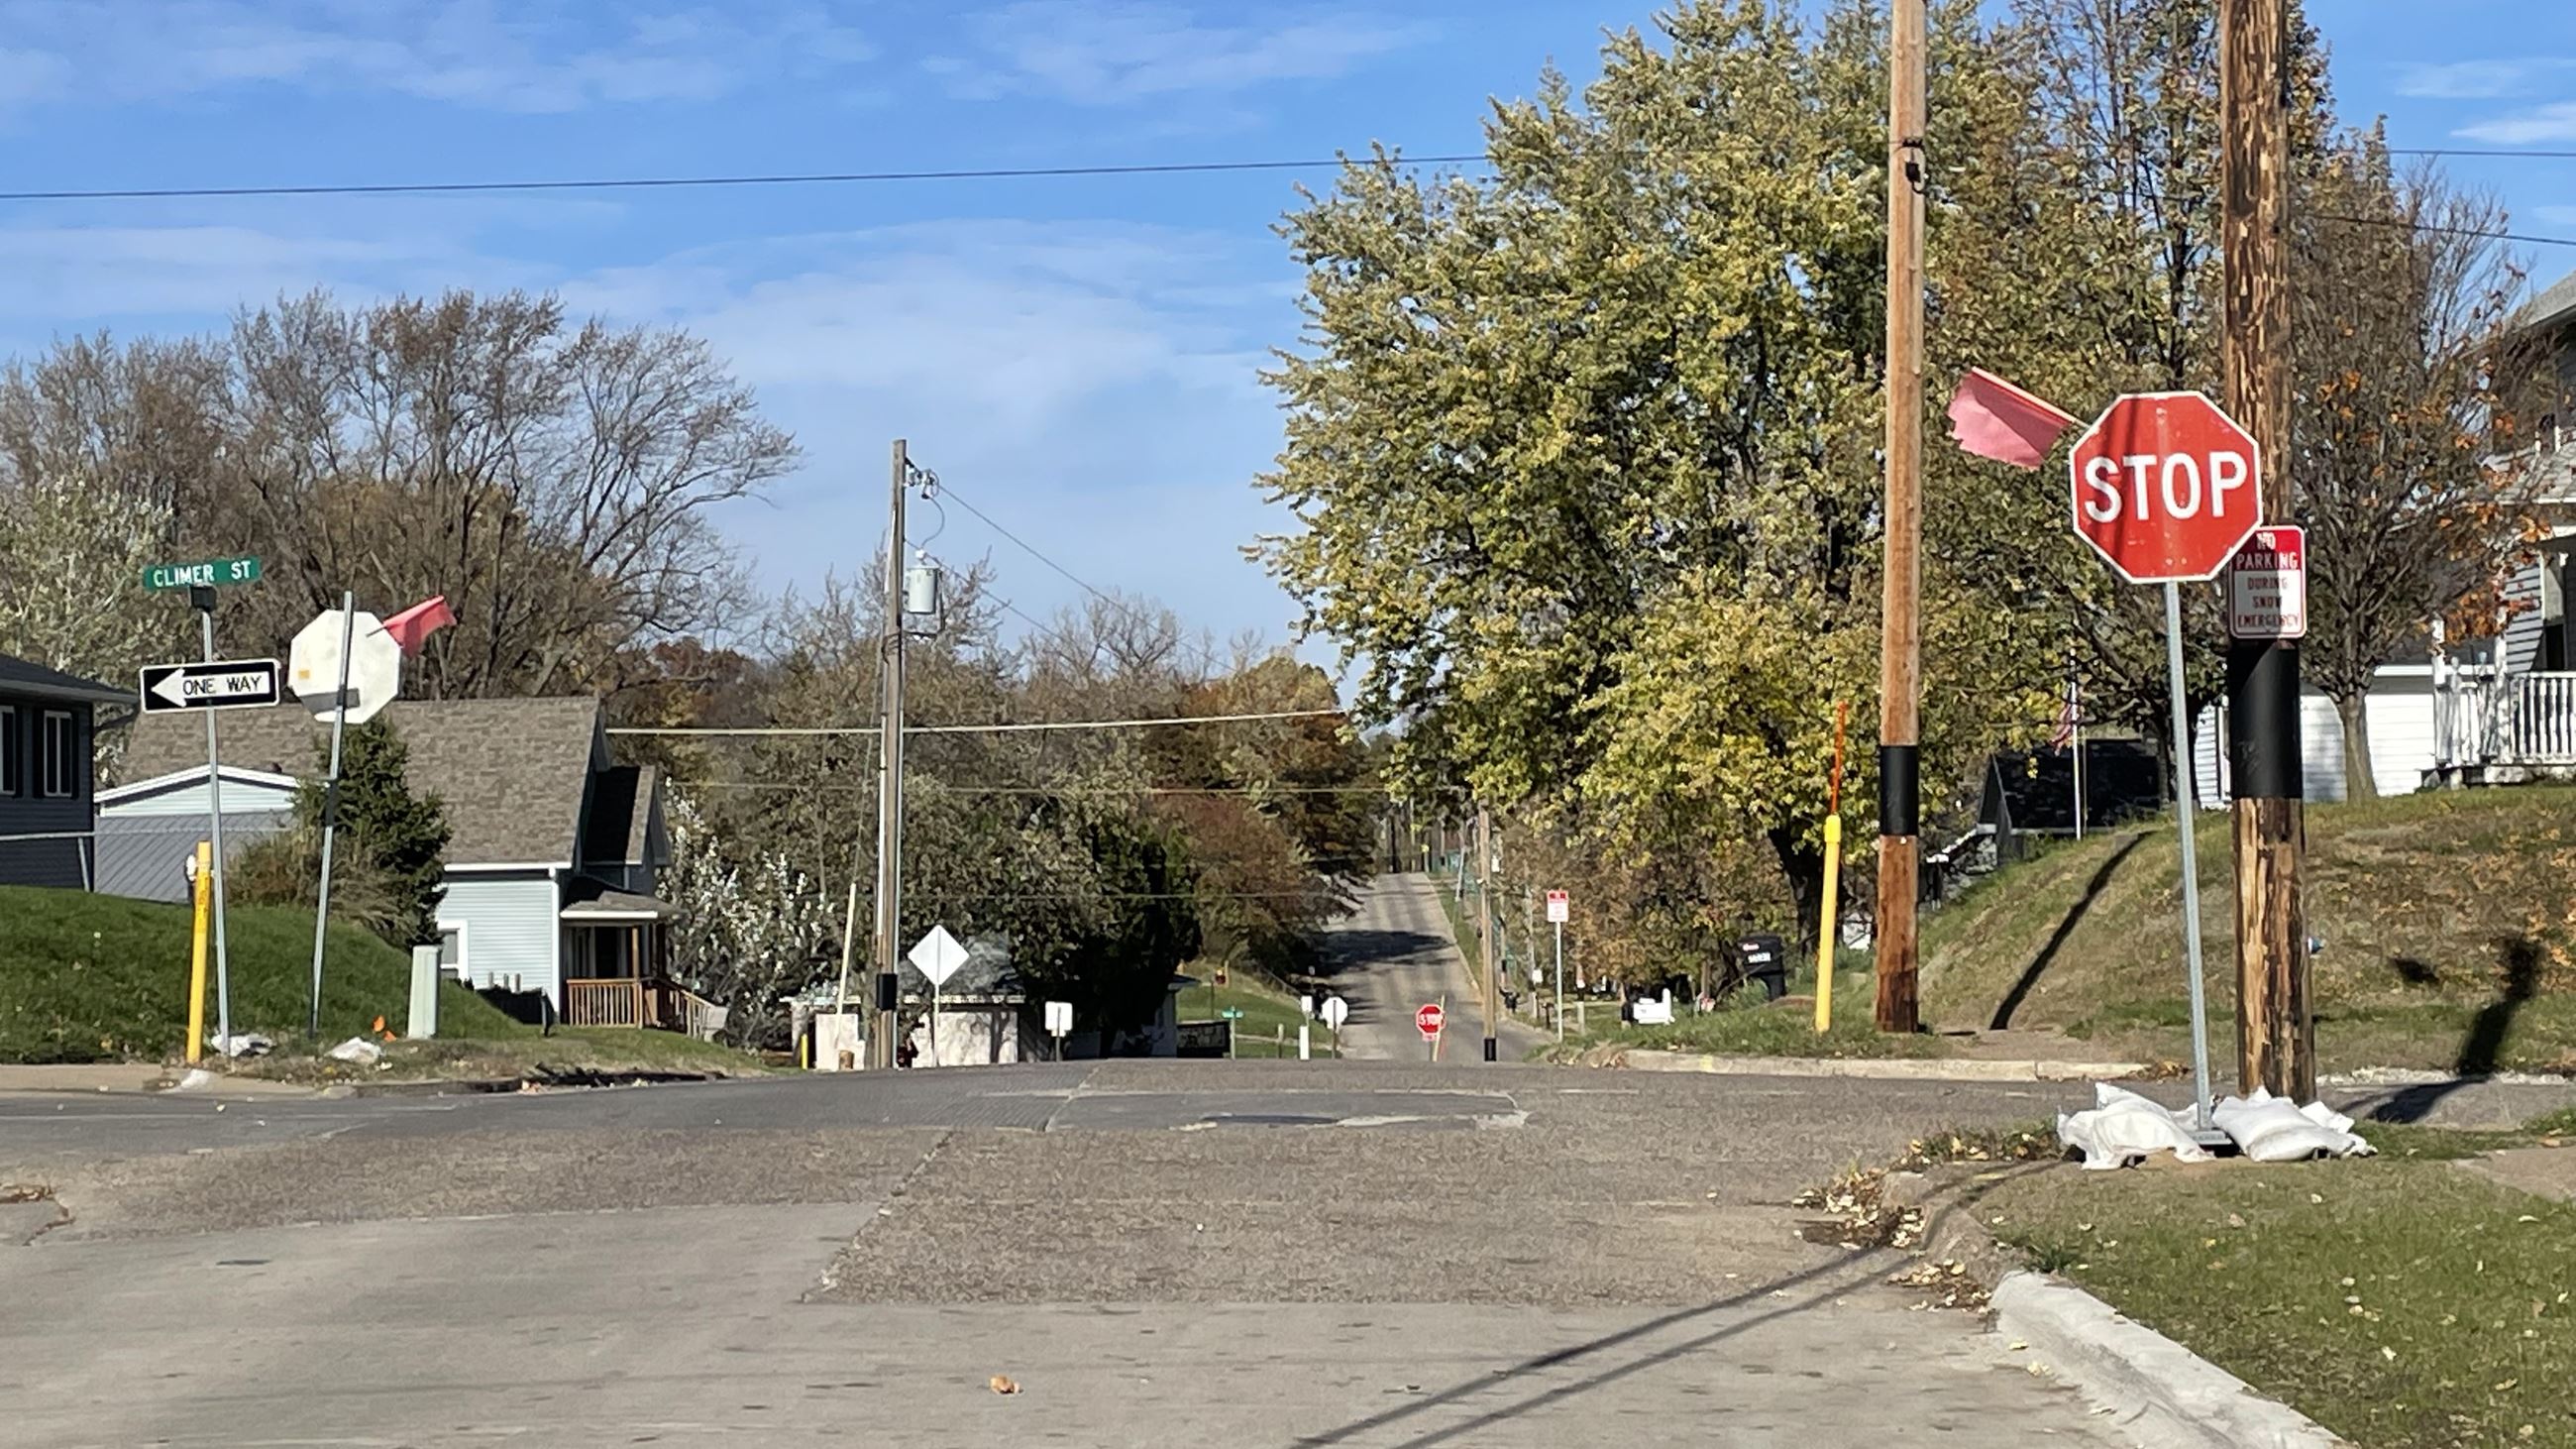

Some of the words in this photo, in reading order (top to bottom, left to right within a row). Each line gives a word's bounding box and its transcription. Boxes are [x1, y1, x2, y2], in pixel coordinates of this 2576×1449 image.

[2084, 451, 2248, 523] STOP
[2256, 531, 2277, 550] NO
[2236, 551, 2299, 571] PARKING
[153, 564, 215, 588] CLIMER
[231, 560, 252, 580] ST
[2247, 577, 2289, 591] DURING
[2252, 596, 2283, 609] SNOW
[2237, 613, 2300, 628] EMERGENCY
[182, 678, 217, 696] ONE
[226, 675, 262, 693] WAY
[1418, 1013, 1443, 1027] STOP
